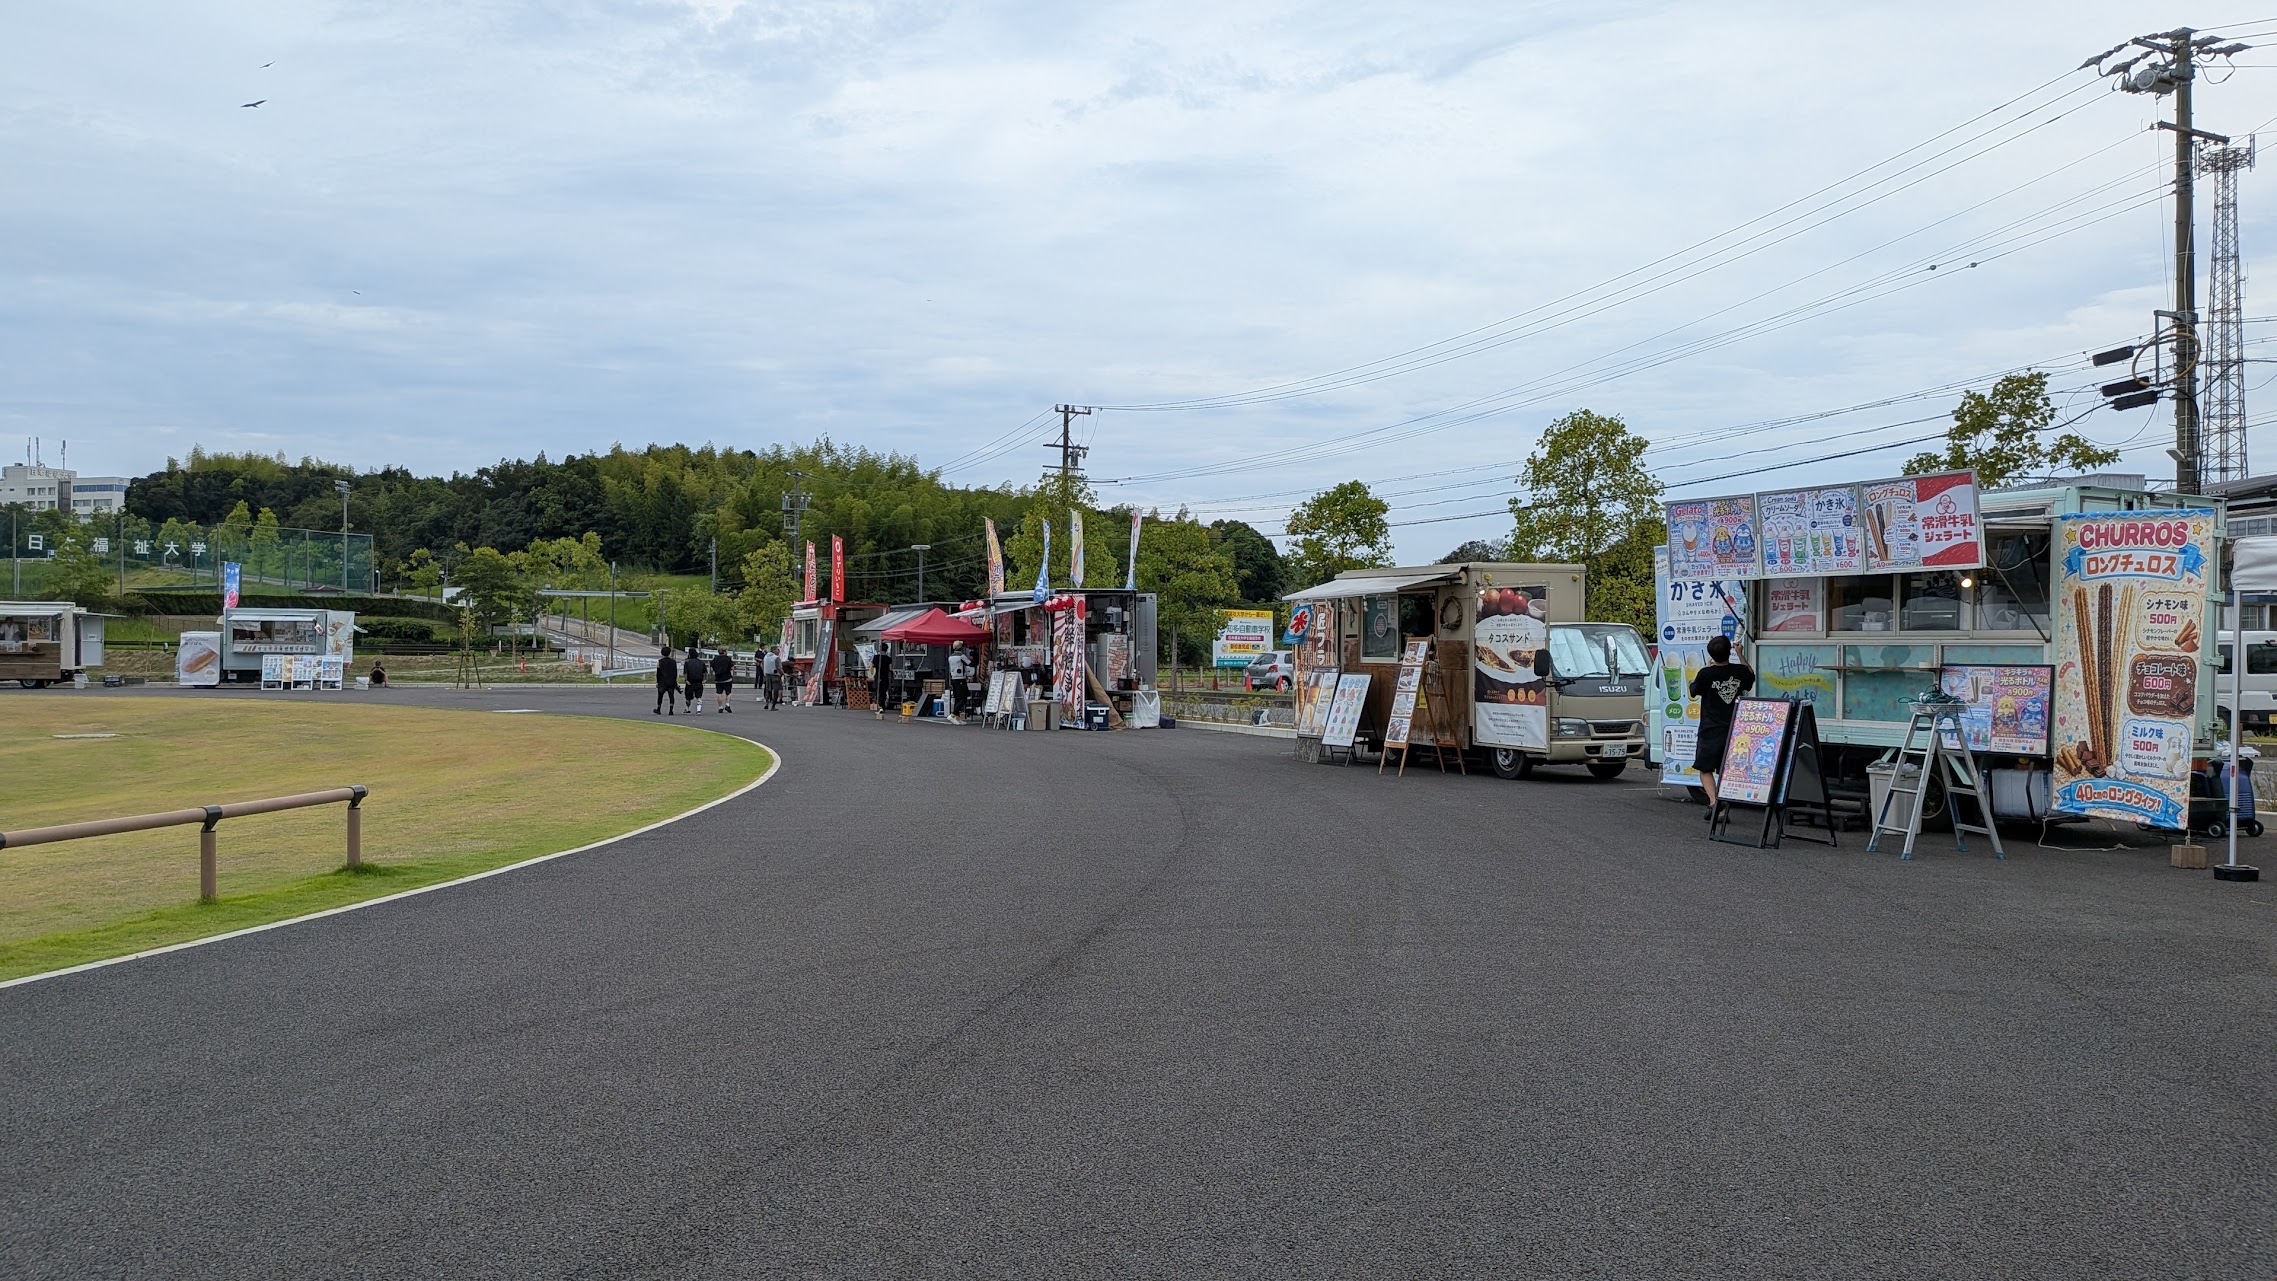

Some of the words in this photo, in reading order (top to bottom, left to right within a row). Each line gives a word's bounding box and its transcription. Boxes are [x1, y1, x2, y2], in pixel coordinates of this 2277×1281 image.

[1767, 496, 1784, 504] Cream
[1868, 487, 1912, 502] ロングチュロス
[1675, 505, 1702, 516] Gelato
[1765, 504, 1799, 515] クリームソーダ
[1815, 497, 1846, 512] かき氷
[1922, 513, 1975, 530] 常滑牛乳
[1924, 529, 1973, 542] ジェラート
[2079, 521, 2189, 549] CHURROS
[2086, 553, 2177, 576] ロングチュロス
[1772, 602, 1809, 611] ジェラート
[2146, 599, 2189, 611] シナモン味
[1290, 610, 1308, 634] 氷
[2149, 613, 2177, 625] 500円
[1488, 632, 1531, 644] タコスサンド
[1779, 652, 1818, 677] Happy
[2136, 663, 2187, 677] チョコレート味
[2000, 676, 2036, 686] 光るボトル
[2143, 677, 2172, 690] 600円
[1598, 685, 1628, 693] ISUZU
[1740, 710, 1774, 722] 光るボトル
[1745, 724, 1771, 735] 各900円
[2131, 726, 2164, 740] ミルク味
[2132, 740, 2159, 752] 500円
[2075, 784, 2162, 814] 40cmのロングタイプ!
